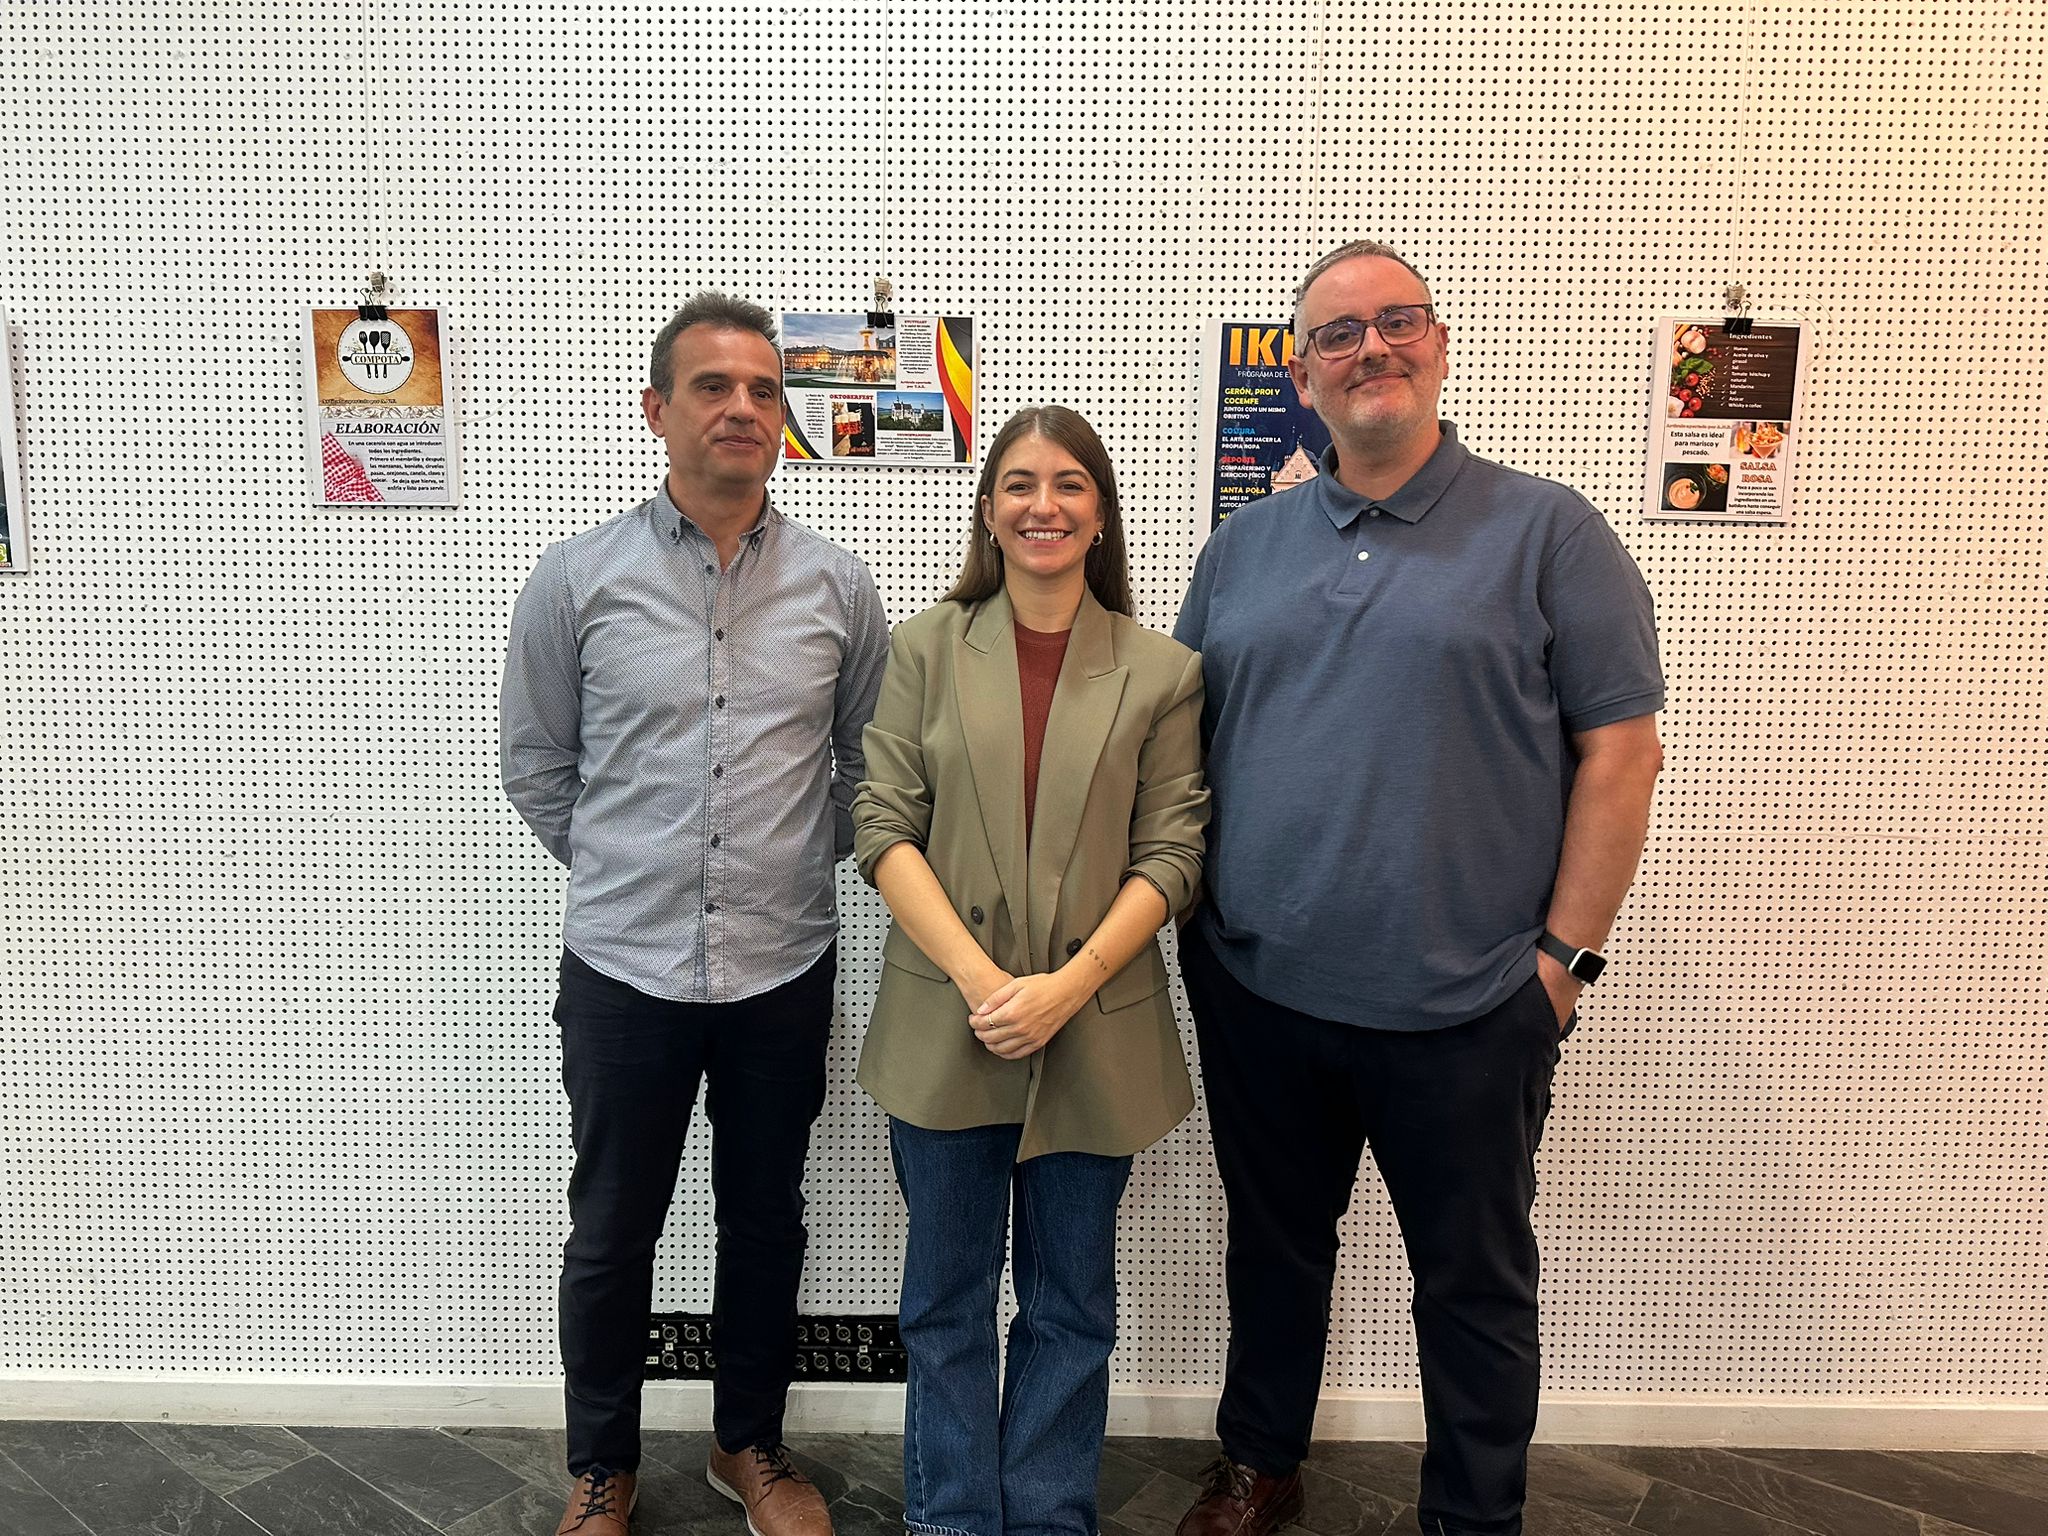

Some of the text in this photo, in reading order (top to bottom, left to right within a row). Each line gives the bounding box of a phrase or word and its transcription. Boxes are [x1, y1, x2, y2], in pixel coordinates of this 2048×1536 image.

[354, 355, 400, 364] COMPOTA
[1237, 370, 1273, 378] PROGRAMA
[1224, 387, 1253, 397] GERÓN,
[1275, 388, 1280, 397] Y
[1224, 397, 1259, 405] COCEMFE
[335, 421, 441, 435] ELABORACIÓN
[1222, 427, 1256, 435] COSTURA
[1740, 461, 1777, 471] SALSA
[1741, 474, 1773, 483] ROSA
